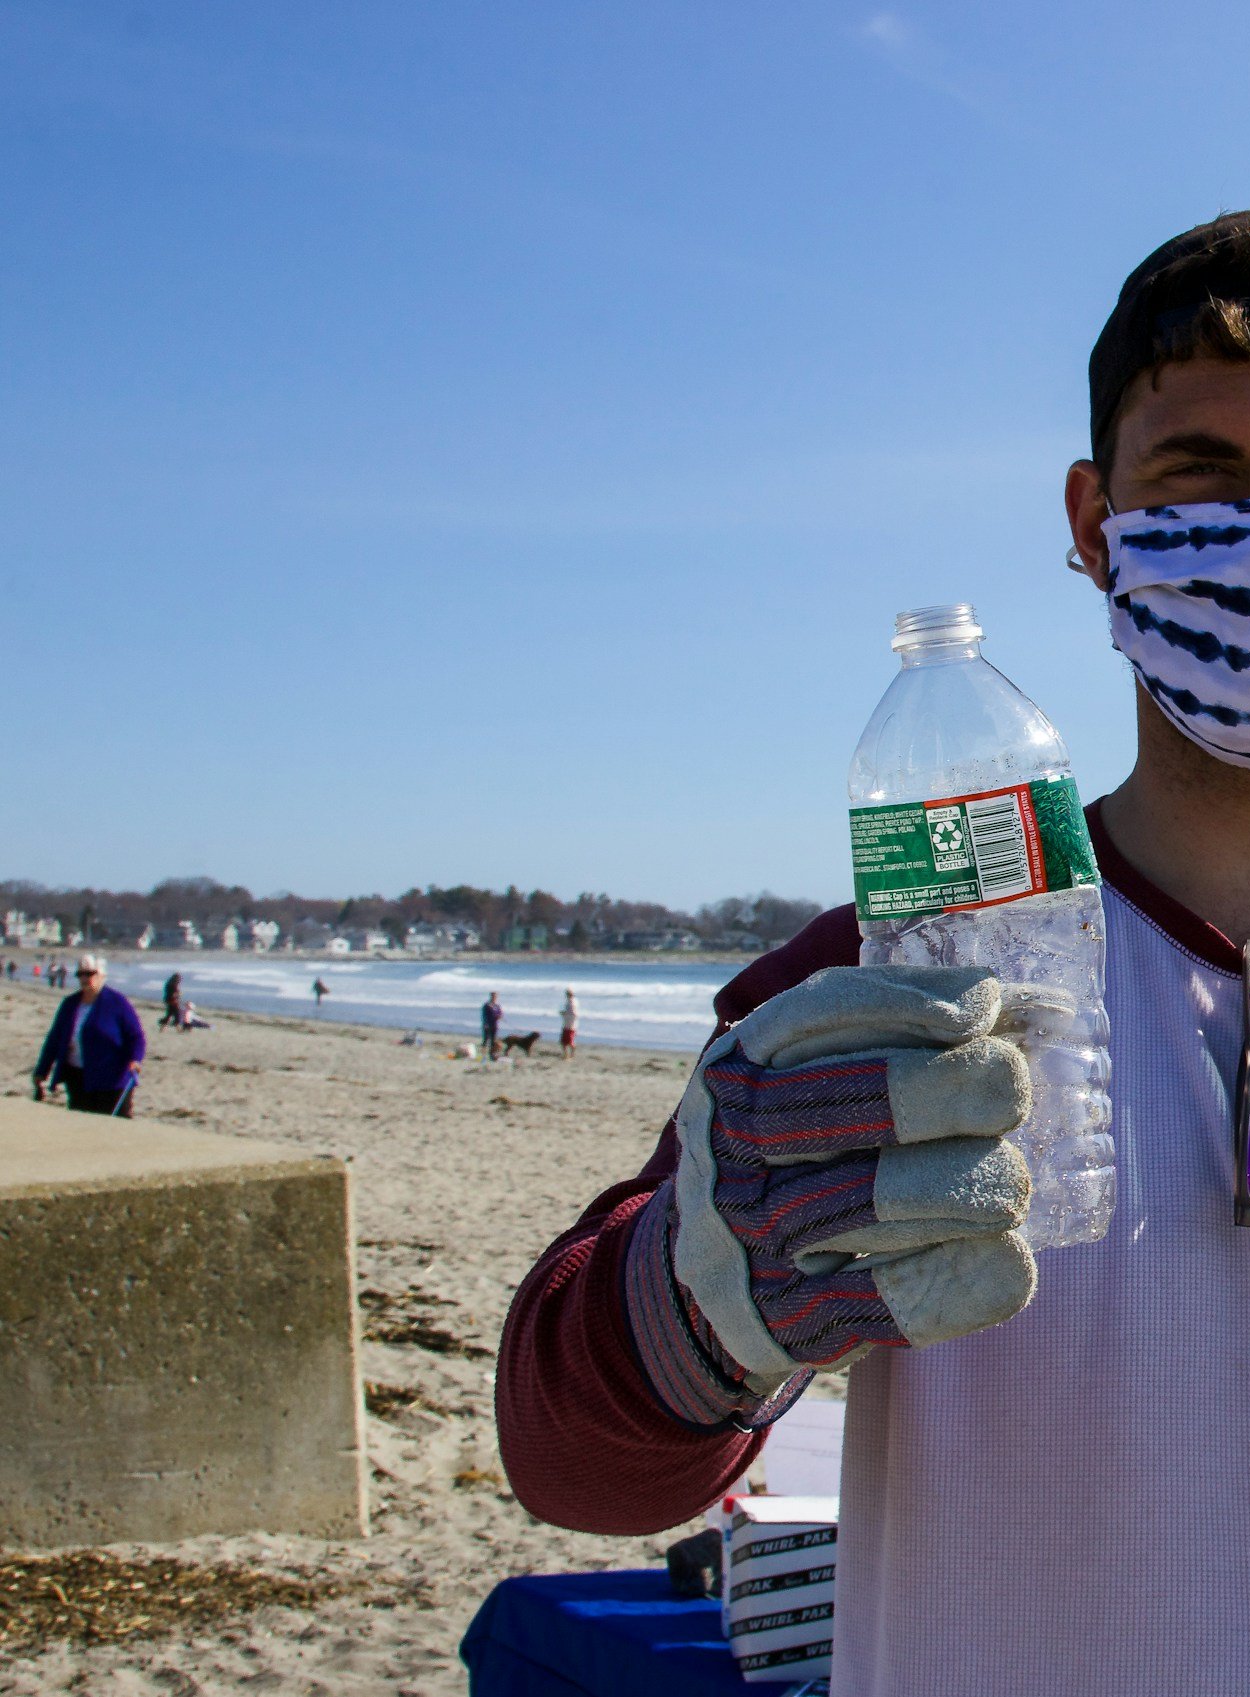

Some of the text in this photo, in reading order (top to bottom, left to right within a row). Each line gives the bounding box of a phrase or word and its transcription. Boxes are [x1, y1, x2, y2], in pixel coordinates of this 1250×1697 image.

[1020, 791, 1029, 809] STATES
[1012, 811, 1023, 840] 48127
[1024, 811, 1033, 831] DEPOSIT
[1029, 831, 1037, 849] BOTTLE
[936, 853, 965, 862] PLASTIC
[940, 861, 965, 869] BOTTLE
[1018, 845, 1028, 873] 75720
[893, 893, 903, 901] Cap
[904, 892, 909, 900] is
[914, 890, 929, 899] small
[930, 888, 941, 898] part
[942, 886, 953, 895] and
[954, 886, 970, 895] poses
[914, 897, 943, 908] particularly
[945, 896, 953, 904] for
[751, 1530, 832, 1555] WHIRL-PAK
[749, 1605, 830, 1630] WHIRL-PAK
